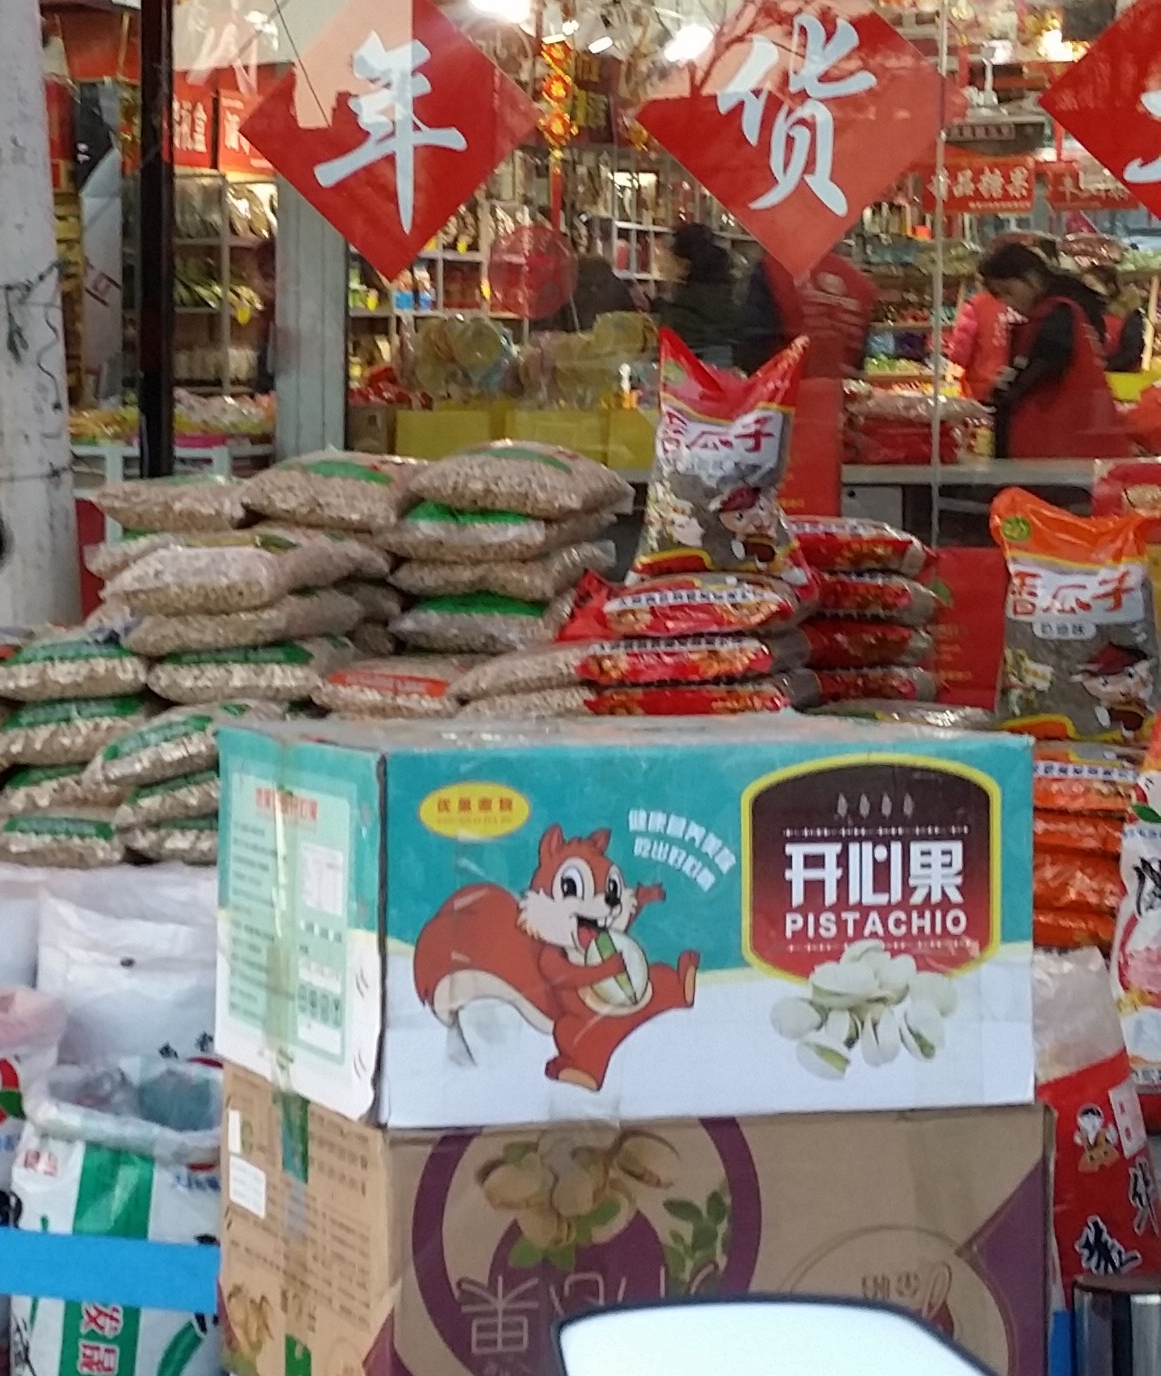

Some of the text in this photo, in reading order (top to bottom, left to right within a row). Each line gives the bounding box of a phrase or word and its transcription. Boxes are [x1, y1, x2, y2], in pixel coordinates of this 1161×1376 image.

[313, 30, 467, 236] 年
[716, 13, 876, 217] 货
[1009, 570, 1135, 617] 香瓜子
[784, 840, 964, 908] 开心果
[785, 908, 968, 940] PISTACHIO
